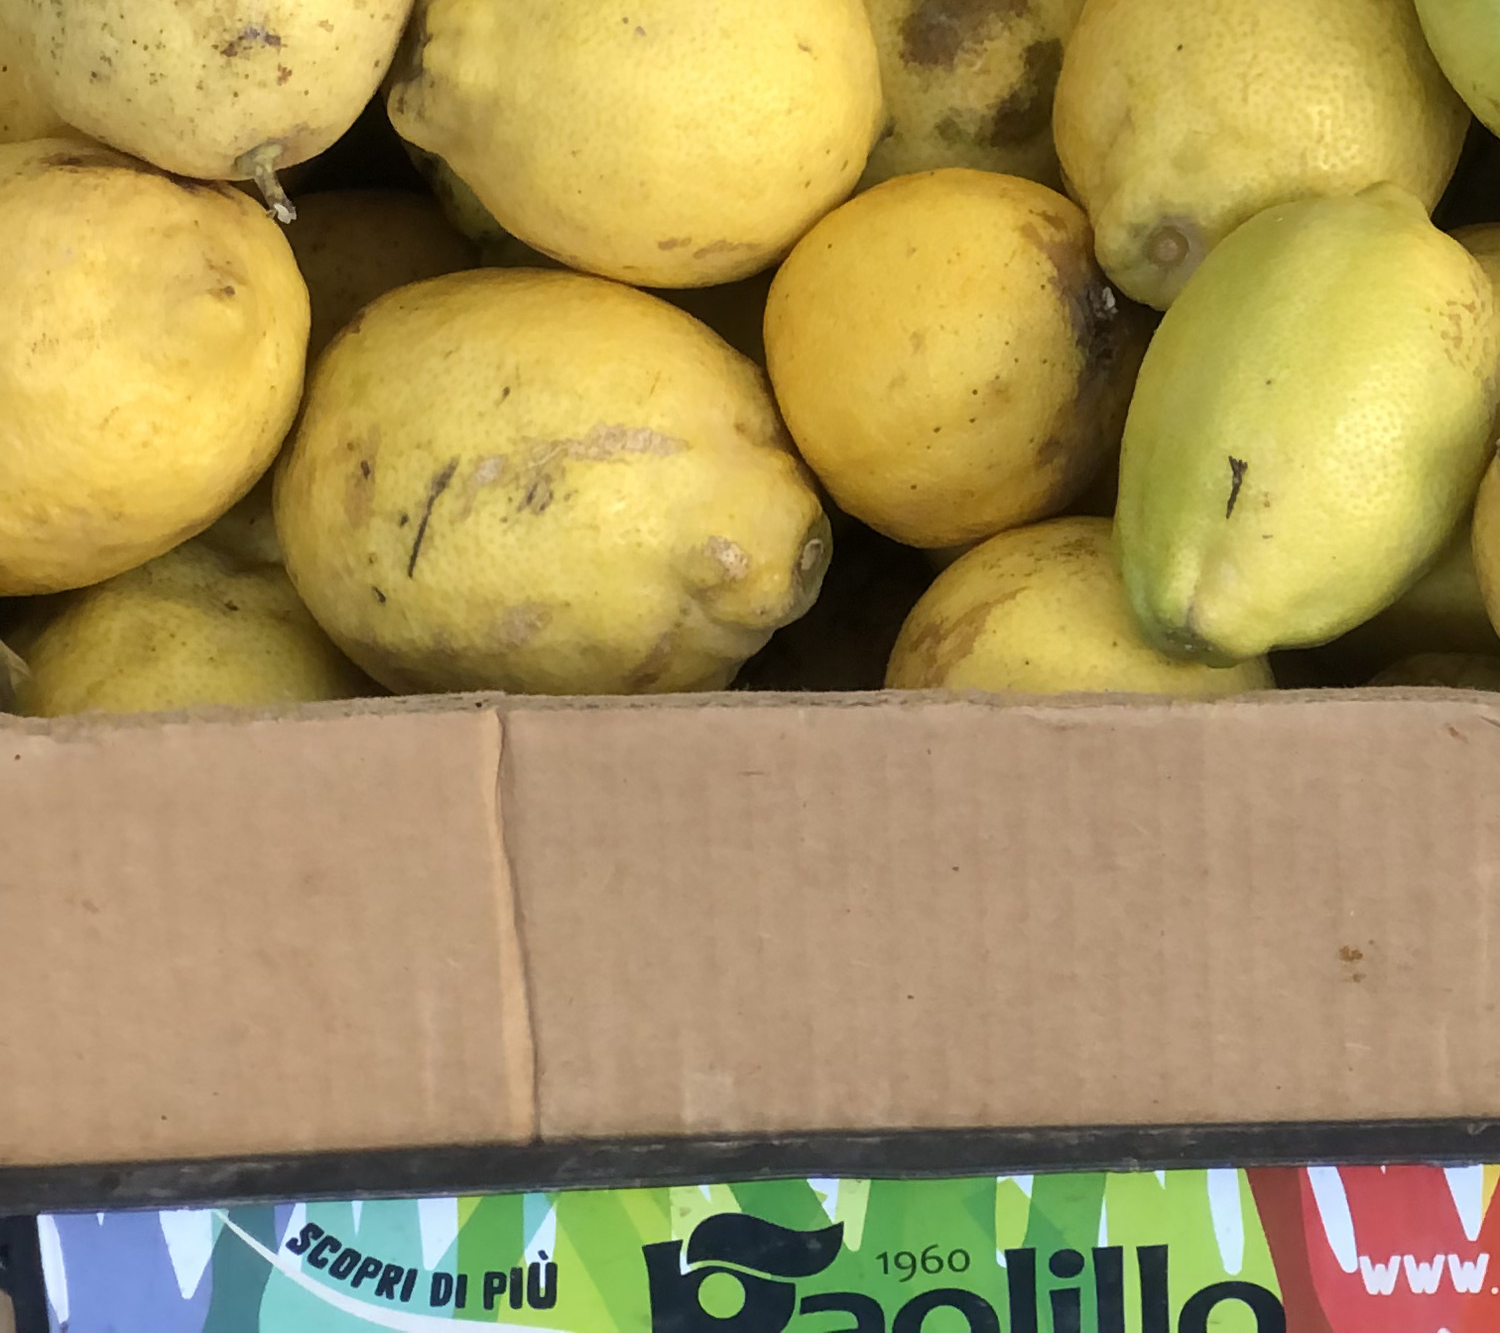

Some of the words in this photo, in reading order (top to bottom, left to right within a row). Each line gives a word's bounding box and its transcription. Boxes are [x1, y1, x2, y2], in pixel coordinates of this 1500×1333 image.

[285, 1222, 417, 1302] SCOPRI
[430, 1270, 468, 1309] DI
[483, 1249, 558, 1311] PIÙ
[875, 1243, 971, 1283] 1960
